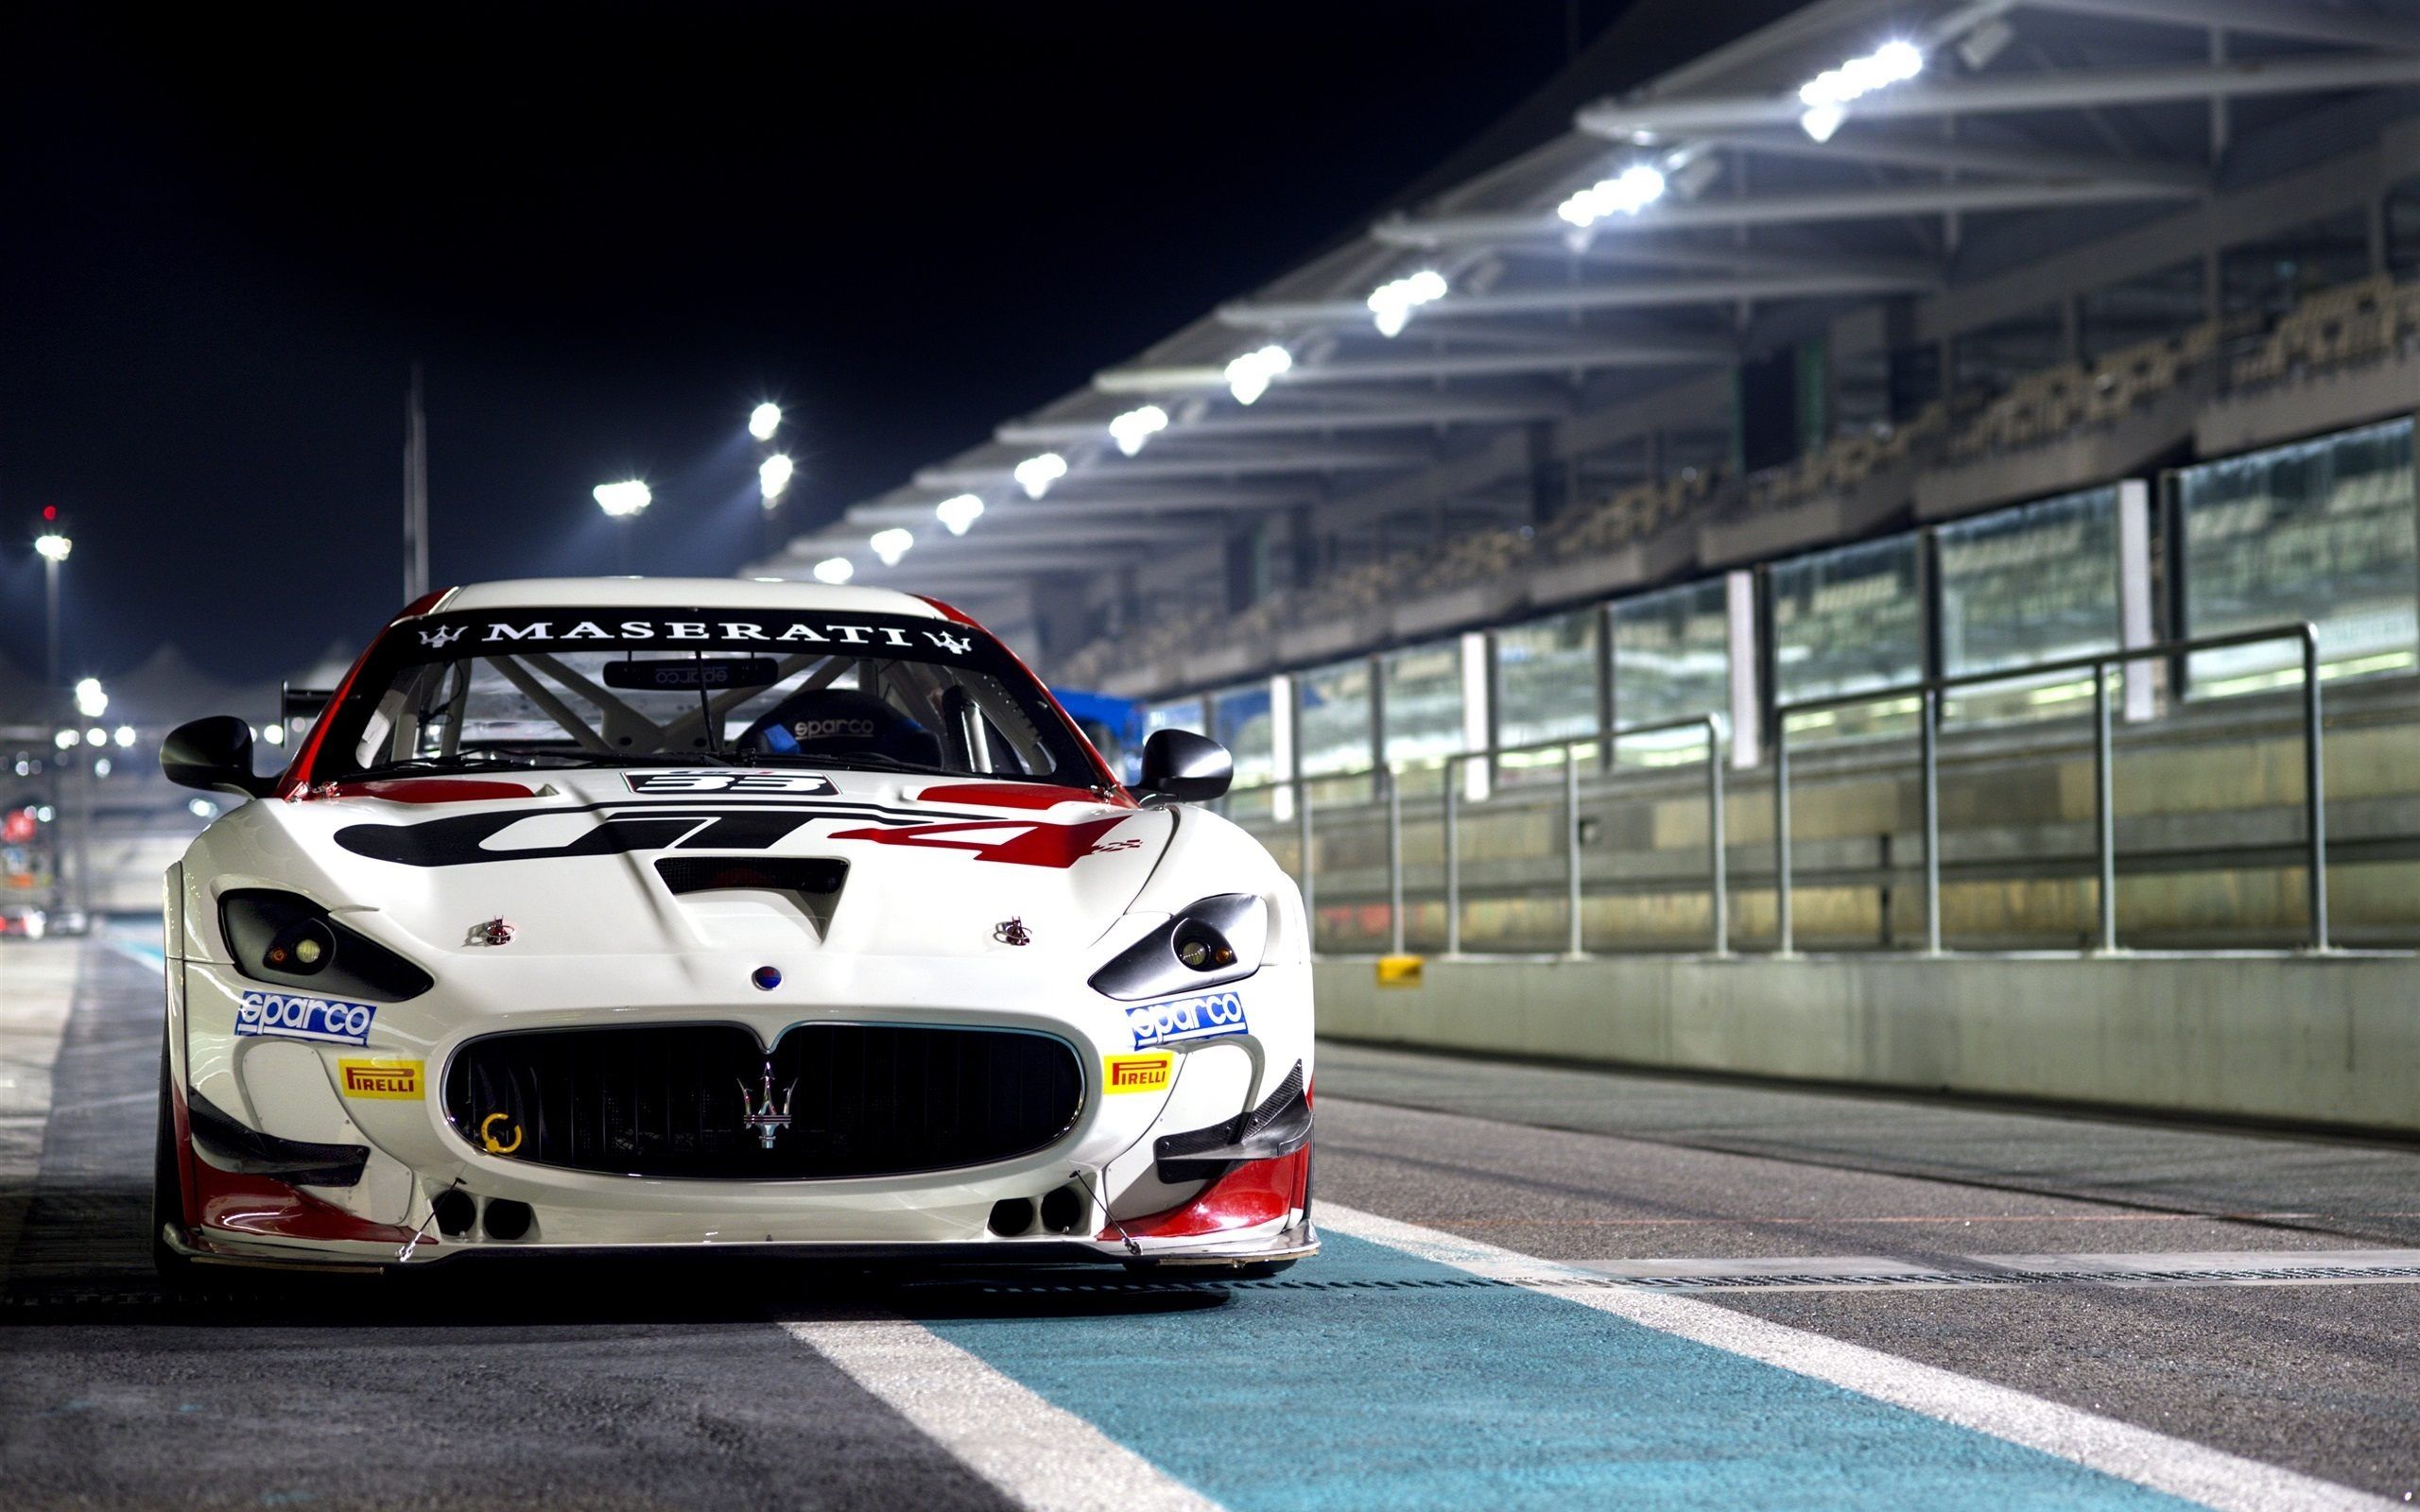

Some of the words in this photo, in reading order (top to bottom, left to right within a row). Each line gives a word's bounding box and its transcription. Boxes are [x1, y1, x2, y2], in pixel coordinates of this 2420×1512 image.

[481, 621, 913, 646] MASERATI
[794, 718, 874, 739] sparco
[635, 775, 827, 792] 33
[242, 992, 371, 1036] sparco
[1132, 992, 1242, 1044] sparco
[345, 1066, 415, 1092] PIRELLI
[1112, 1059, 1167, 1086] PIRELLI
